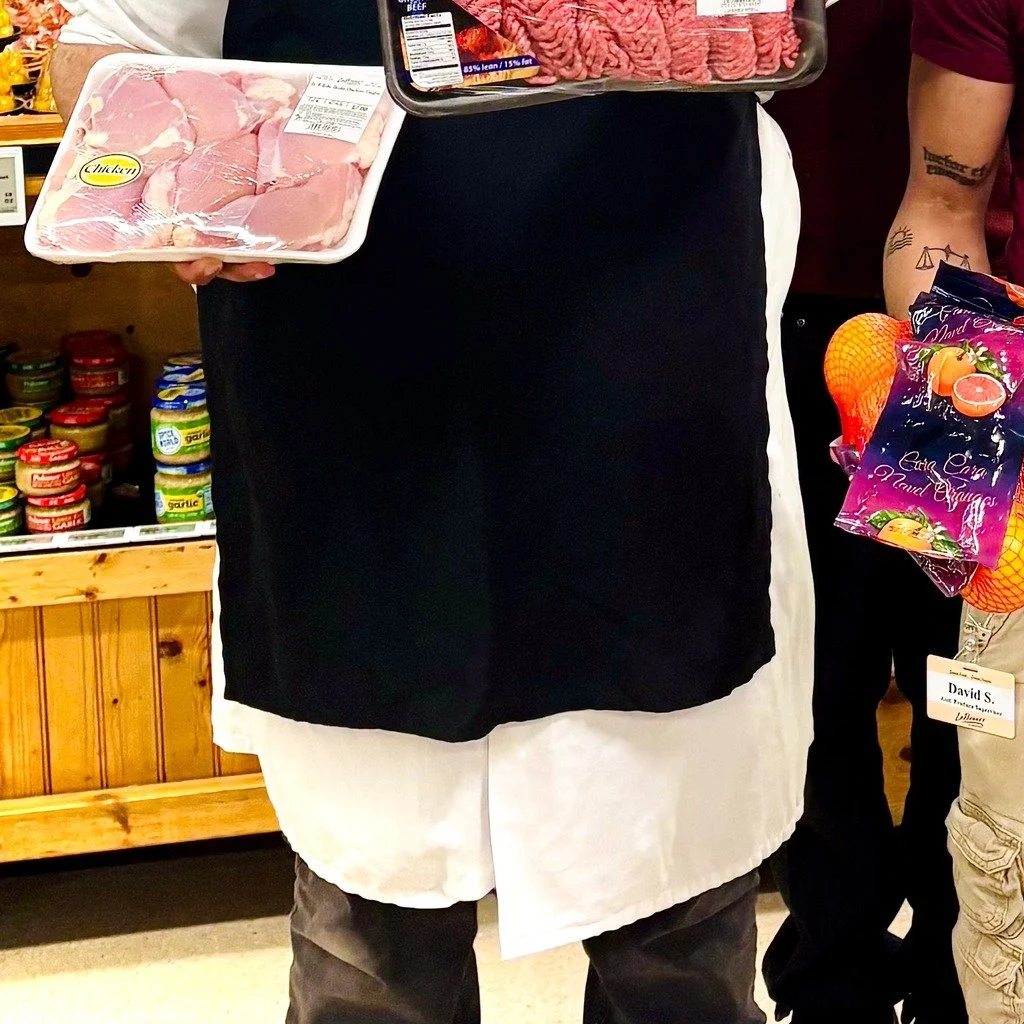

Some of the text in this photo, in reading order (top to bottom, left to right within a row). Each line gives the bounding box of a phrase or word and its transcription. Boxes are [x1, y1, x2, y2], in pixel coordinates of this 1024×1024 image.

[406, 2, 427, 12] BEEF
[463, 63, 480, 73] 85%
[481, 62, 499, 71] lean
[504, 59, 521, 68] 15%
[521, 58, 533, 66] fat
[84, 161, 138, 178] Chicken
[899, 451, 988, 476] Cara Cara
[873, 464, 933, 497] Navel
[167, 499, 199, 511] garlic
[948, 682, 995, 705] David S.
